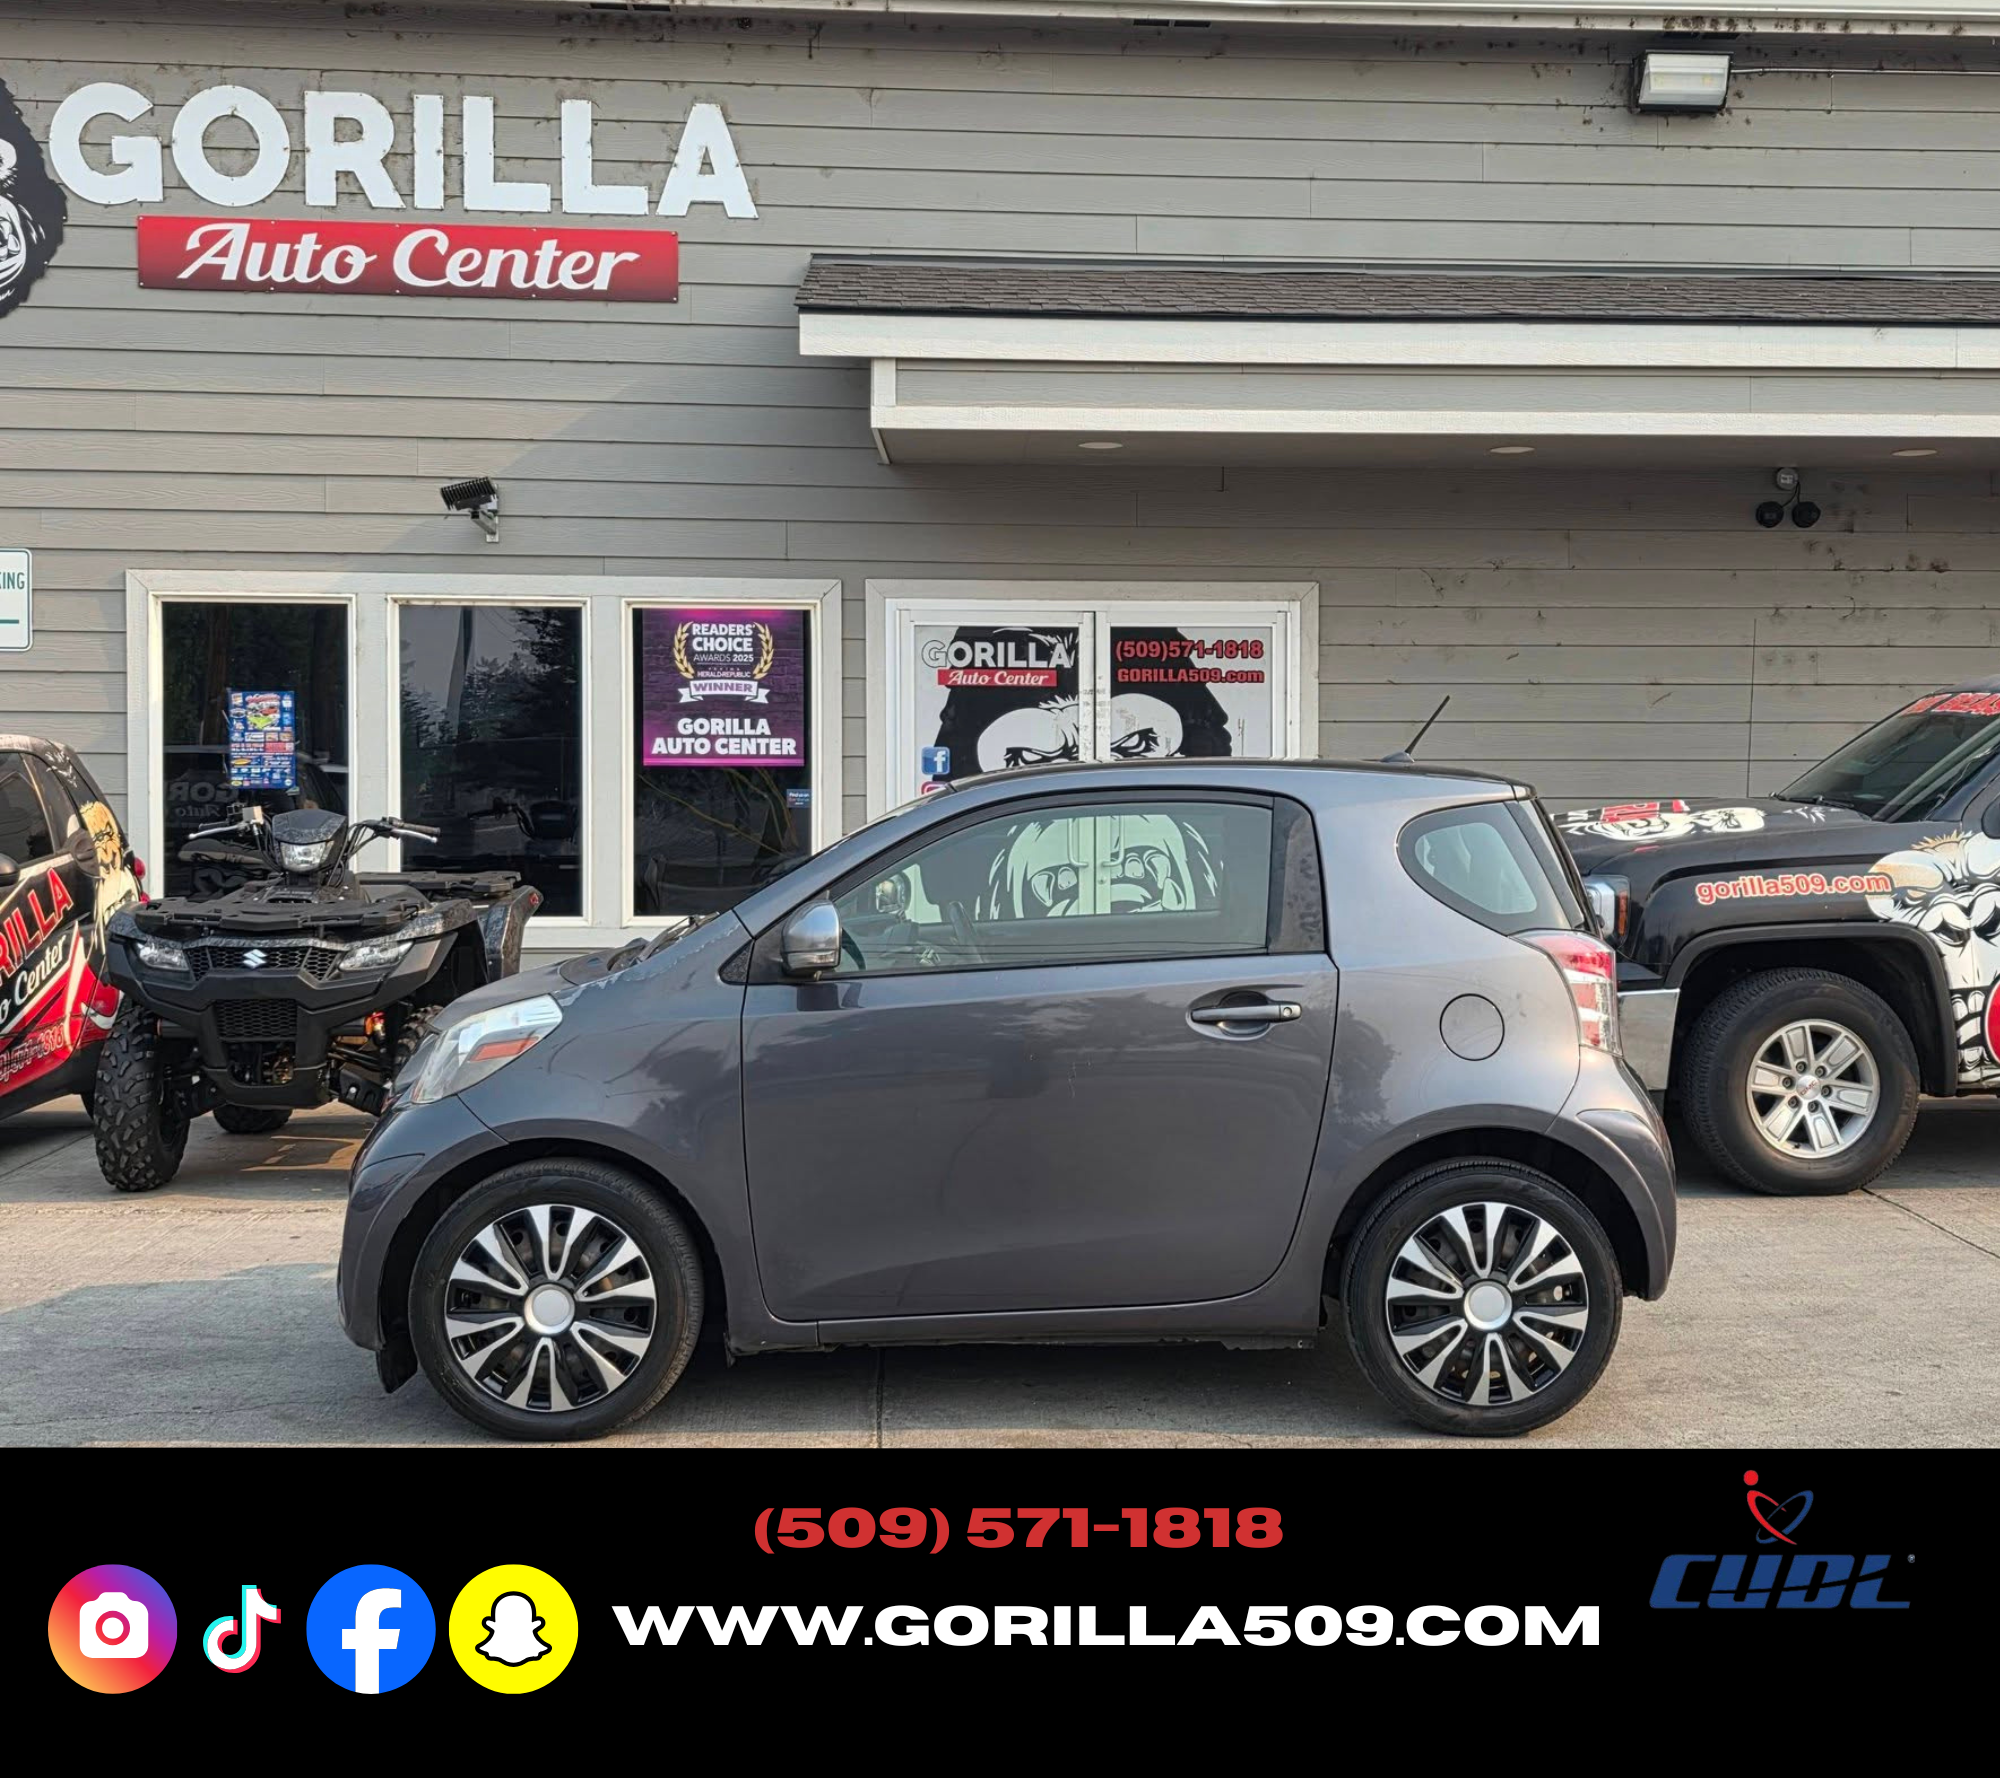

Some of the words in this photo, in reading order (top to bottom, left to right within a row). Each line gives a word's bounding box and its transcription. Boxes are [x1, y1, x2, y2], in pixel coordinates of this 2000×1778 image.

[49, 82, 759, 220] GORILLA
[178, 223, 377, 284] Auto
[393, 228, 640, 292] Center
[0, 571, 25, 590] ING
[692, 623, 755, 636] READERS'
[692, 637, 753, 652] CHOICE
[1116, 640, 1264, 661] (509)571-1818
[693, 653, 731, 662] AWARDS
[732, 653, 754, 663] 2025
[921, 639, 1072, 669] GORILLA
[947, 669, 991, 685] Auto
[994, 670, 1049, 686] Center
[1117, 668, 1265, 683] GORILLA509.com
[693, 682, 753, 693] WINNER
[677, 718, 771, 735] GORILLA
[652, 737, 711, 755] AUTO
[714, 737, 797, 755] CENTER
[1697, 873, 1892, 905] gorilla509.com
[14, 934, 67, 1006] Center
